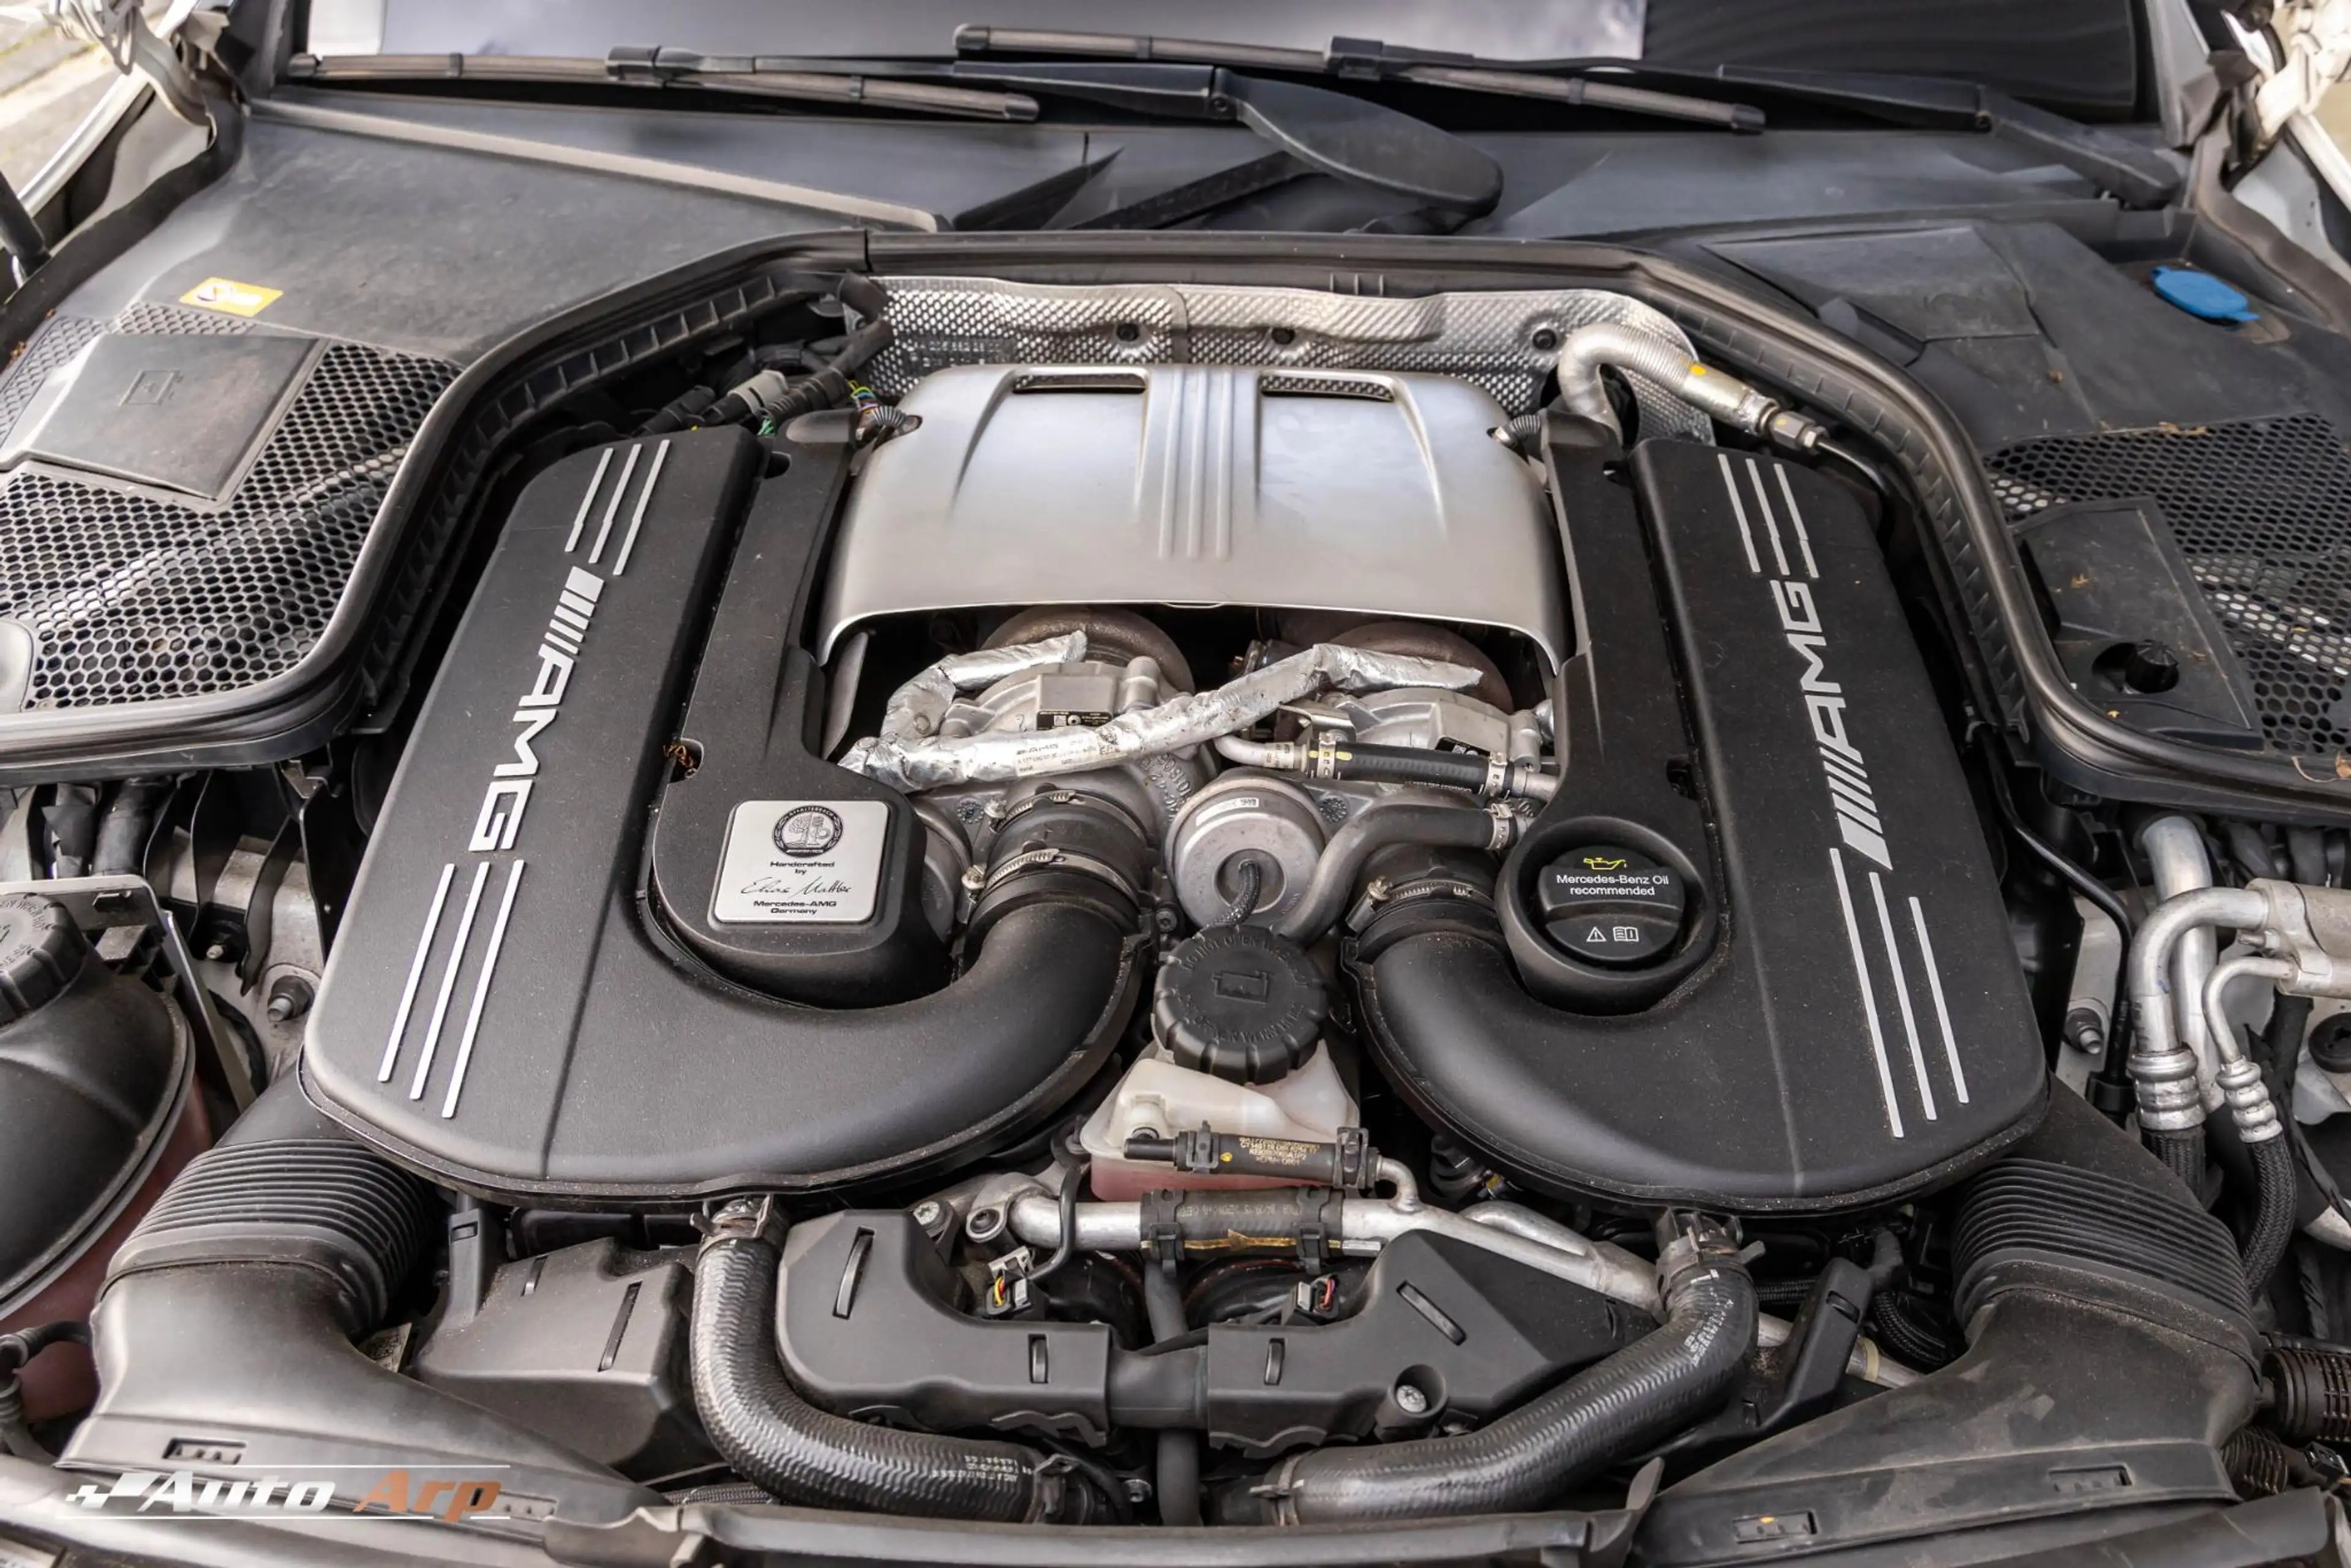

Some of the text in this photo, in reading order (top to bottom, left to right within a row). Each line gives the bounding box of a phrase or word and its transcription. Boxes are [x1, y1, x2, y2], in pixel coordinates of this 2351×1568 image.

[1769, 579, 1865, 765] AMG
[468, 643, 575, 852] AMG
[1556, 874, 1669, 885] Mercedes-Benz Oil
[1570, 886, 1655, 895] recommended
